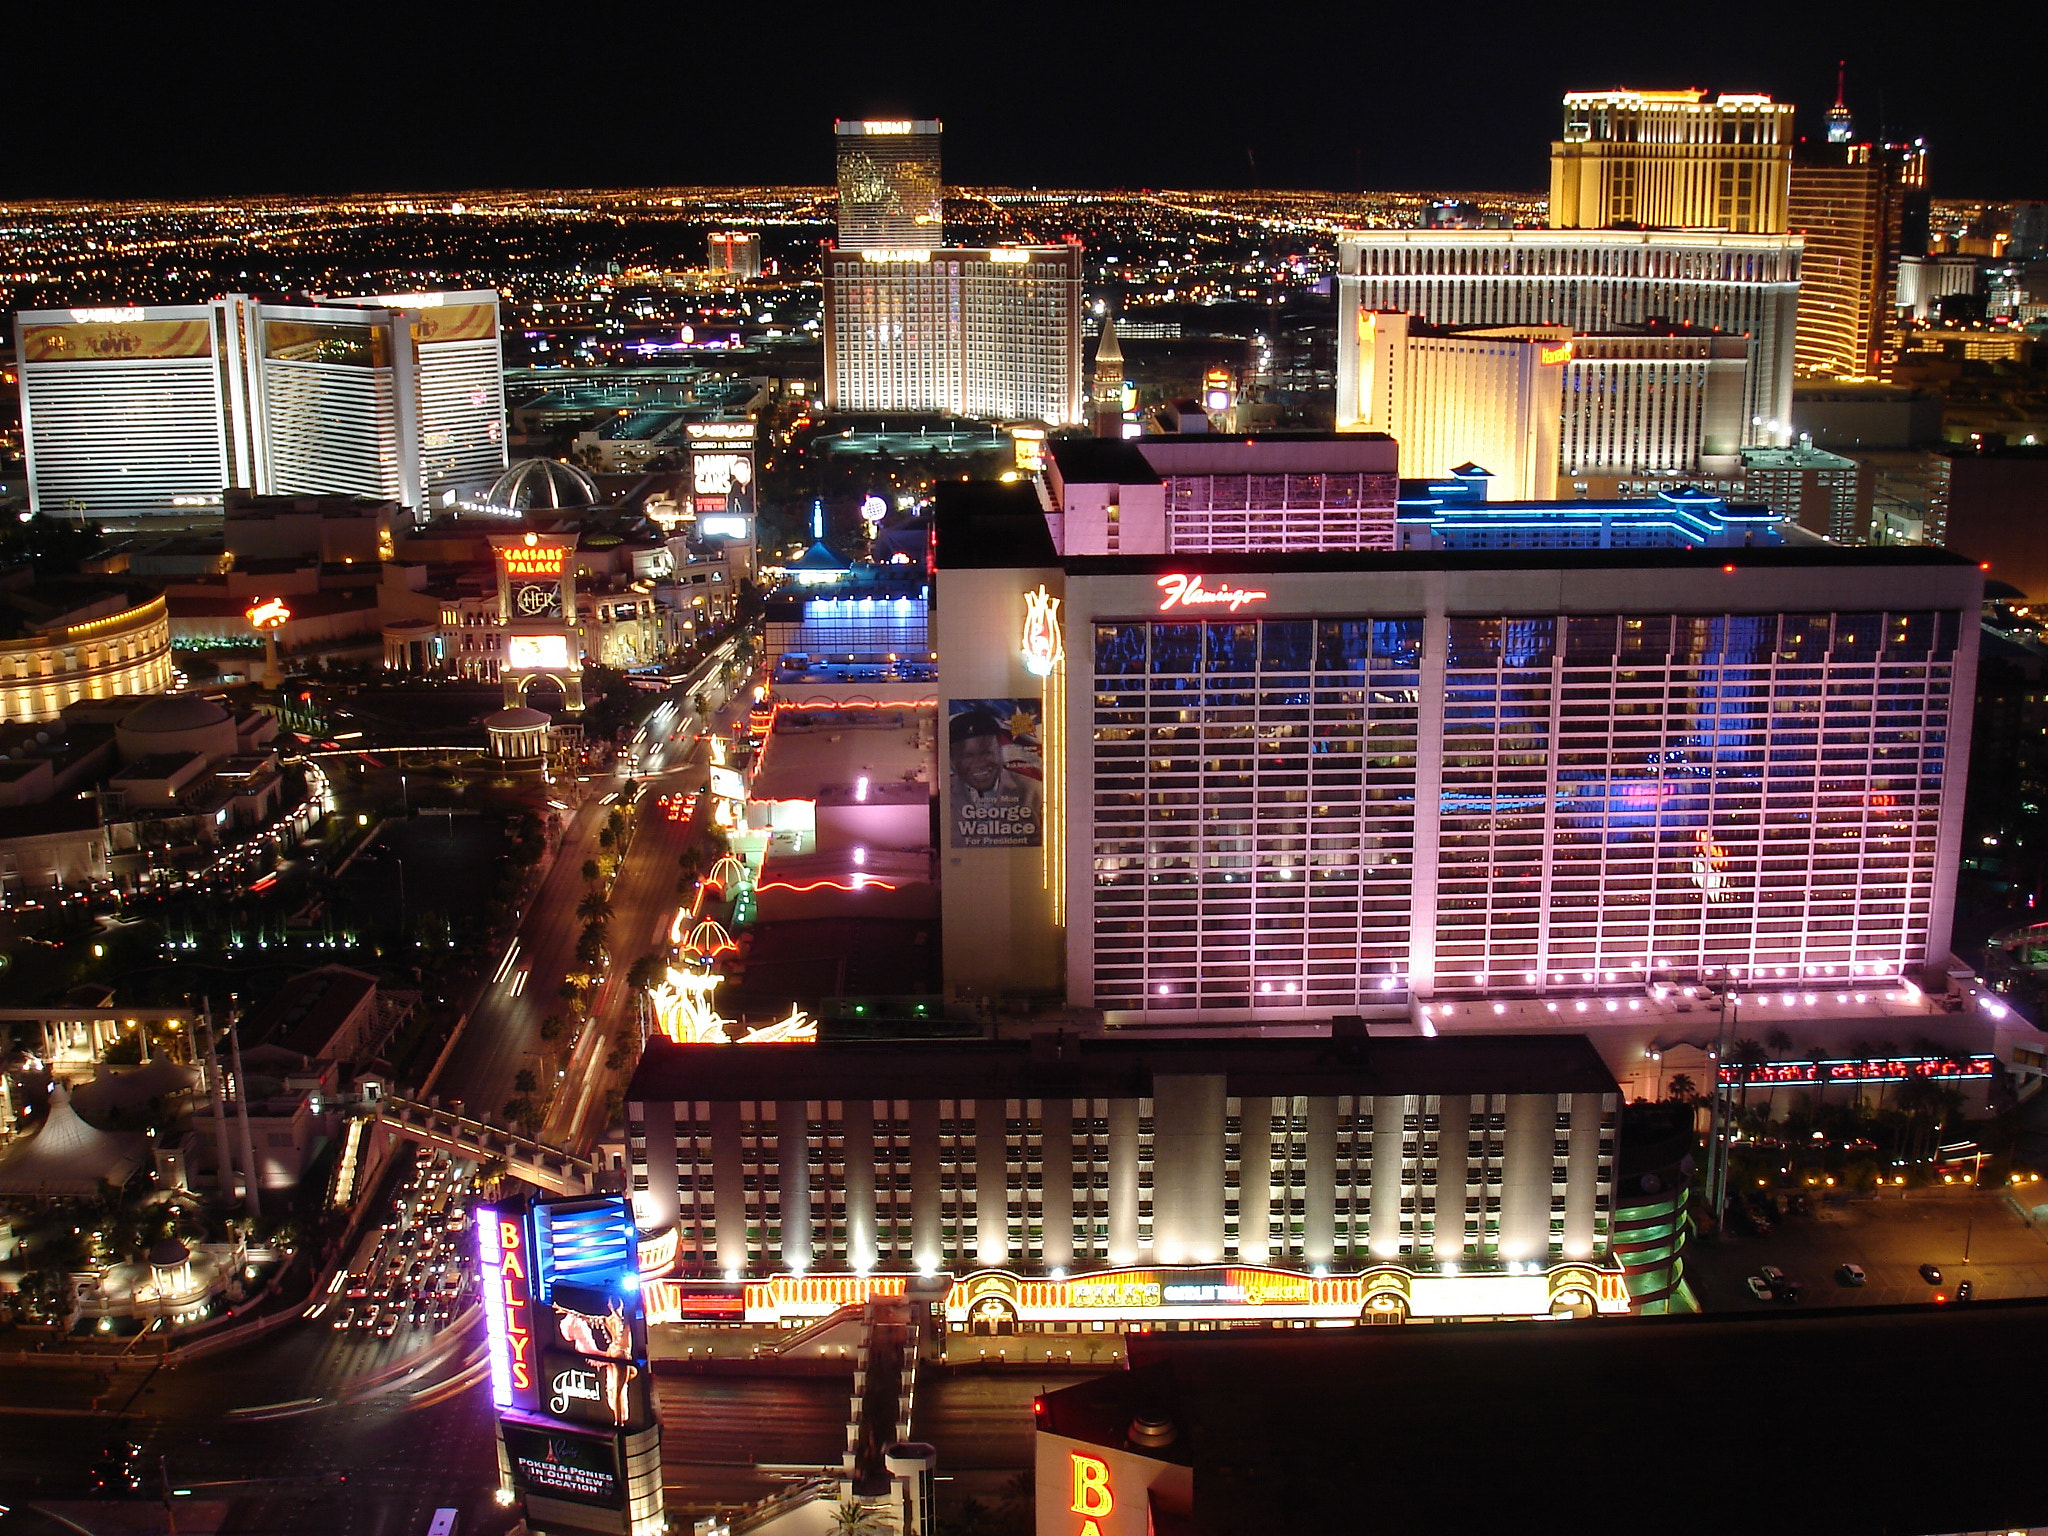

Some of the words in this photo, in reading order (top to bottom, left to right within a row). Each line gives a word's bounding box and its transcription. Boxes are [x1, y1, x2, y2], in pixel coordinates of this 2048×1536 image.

[863, 121, 912, 135] TRUMP
[503, 548, 563, 561] CAESARS
[507, 561, 561, 573] PALACE
[517, 585, 556, 614] CHER
[1156, 573, 1267, 611] Flamingo
[961, 804, 1032, 821] George
[957, 820, 1036, 835] Wallace
[983, 837, 1028, 845] President
[518, 1457, 557, 1471] POKER
[559, 1465, 569, 1473] &
[569, 1466, 613, 1481] PONIES
[531, 1467, 544, 1476] IN
[547, 1469, 573, 1481] OUR
[575, 1475, 603, 1487] NEW
[539, 1476, 598, 1493] LOCATION
